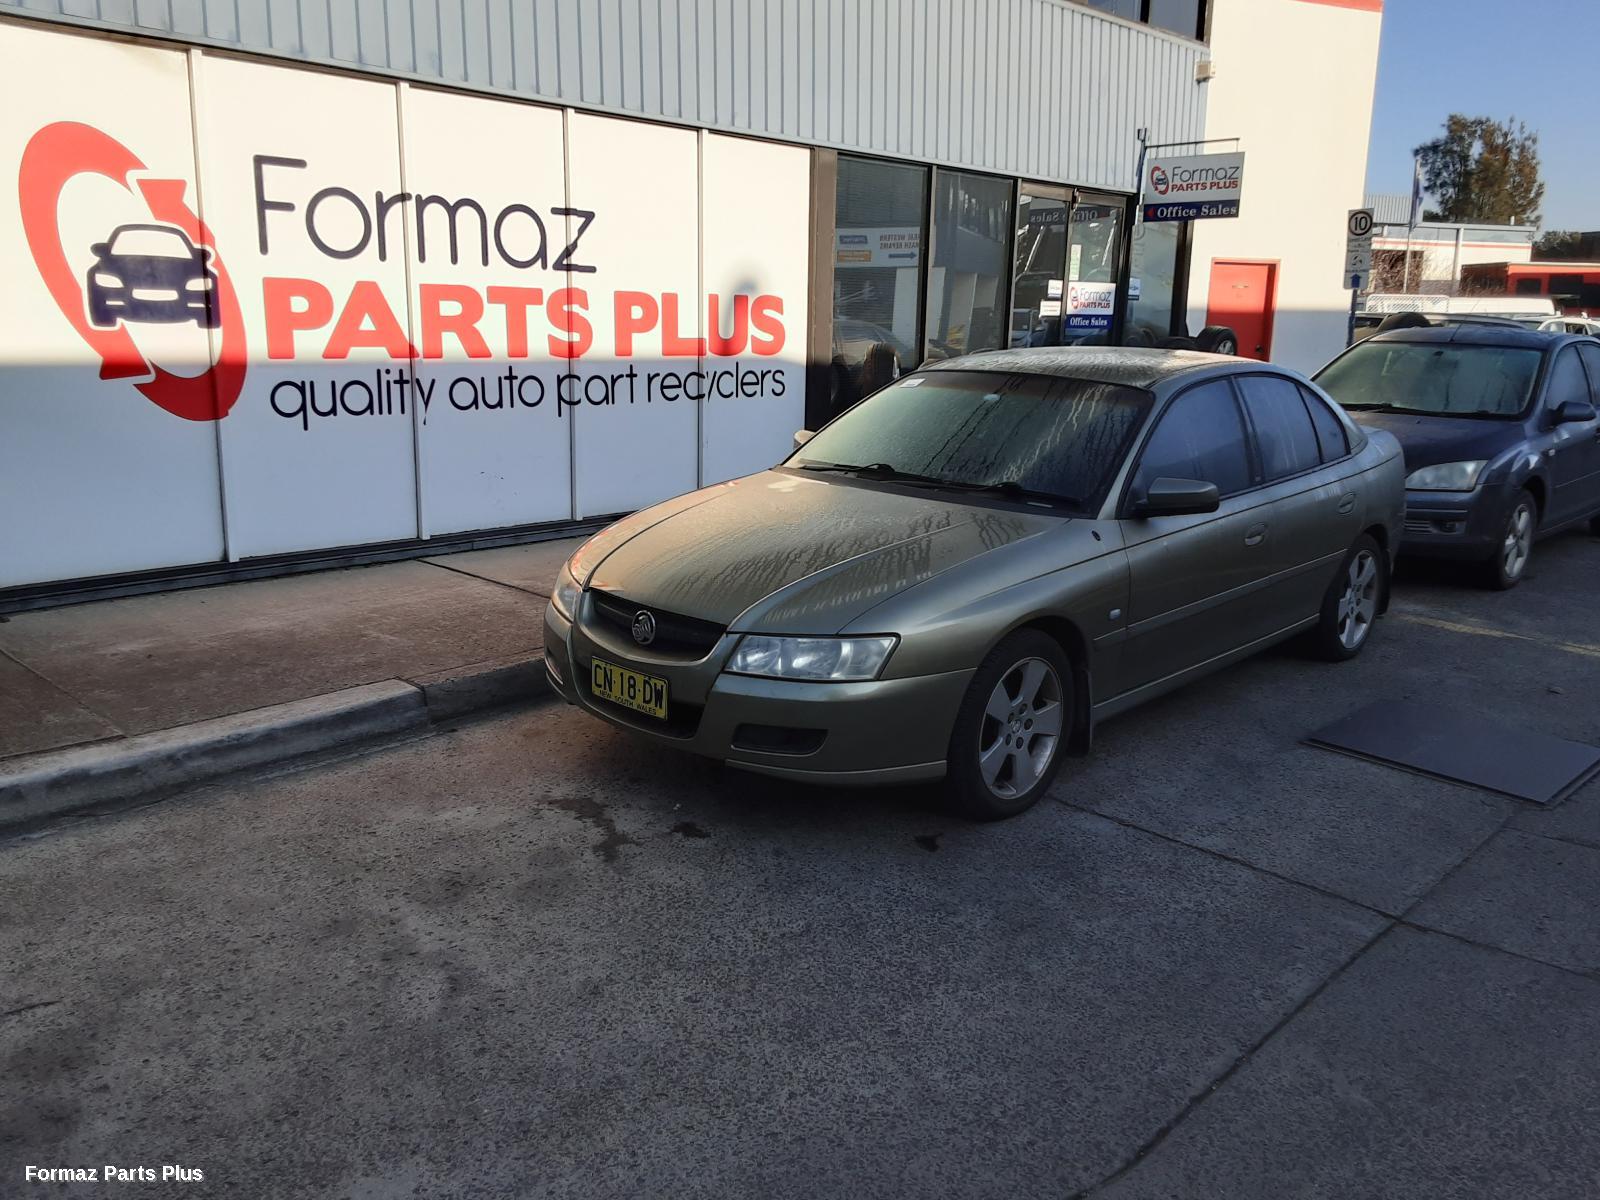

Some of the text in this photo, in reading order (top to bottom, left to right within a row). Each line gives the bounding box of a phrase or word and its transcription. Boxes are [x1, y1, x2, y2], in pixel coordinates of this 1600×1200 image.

[1171, 166, 1240, 183] Formaz
[1170, 179, 1239, 193] PARTS PLUS
[253, 154, 597, 273] Formaz
[1157, 203, 1238, 218] Office Sales
[1354, 216, 1369, 232] 10
[1080, 287, 1112, 302] Formaz
[1080, 301, 1111, 309] PARTS PLUS
[262, 277, 786, 359] PARTS PLUS
[1070, 317, 1108, 327] Office Sales
[270, 361, 786, 431] quality auto part recyclers
